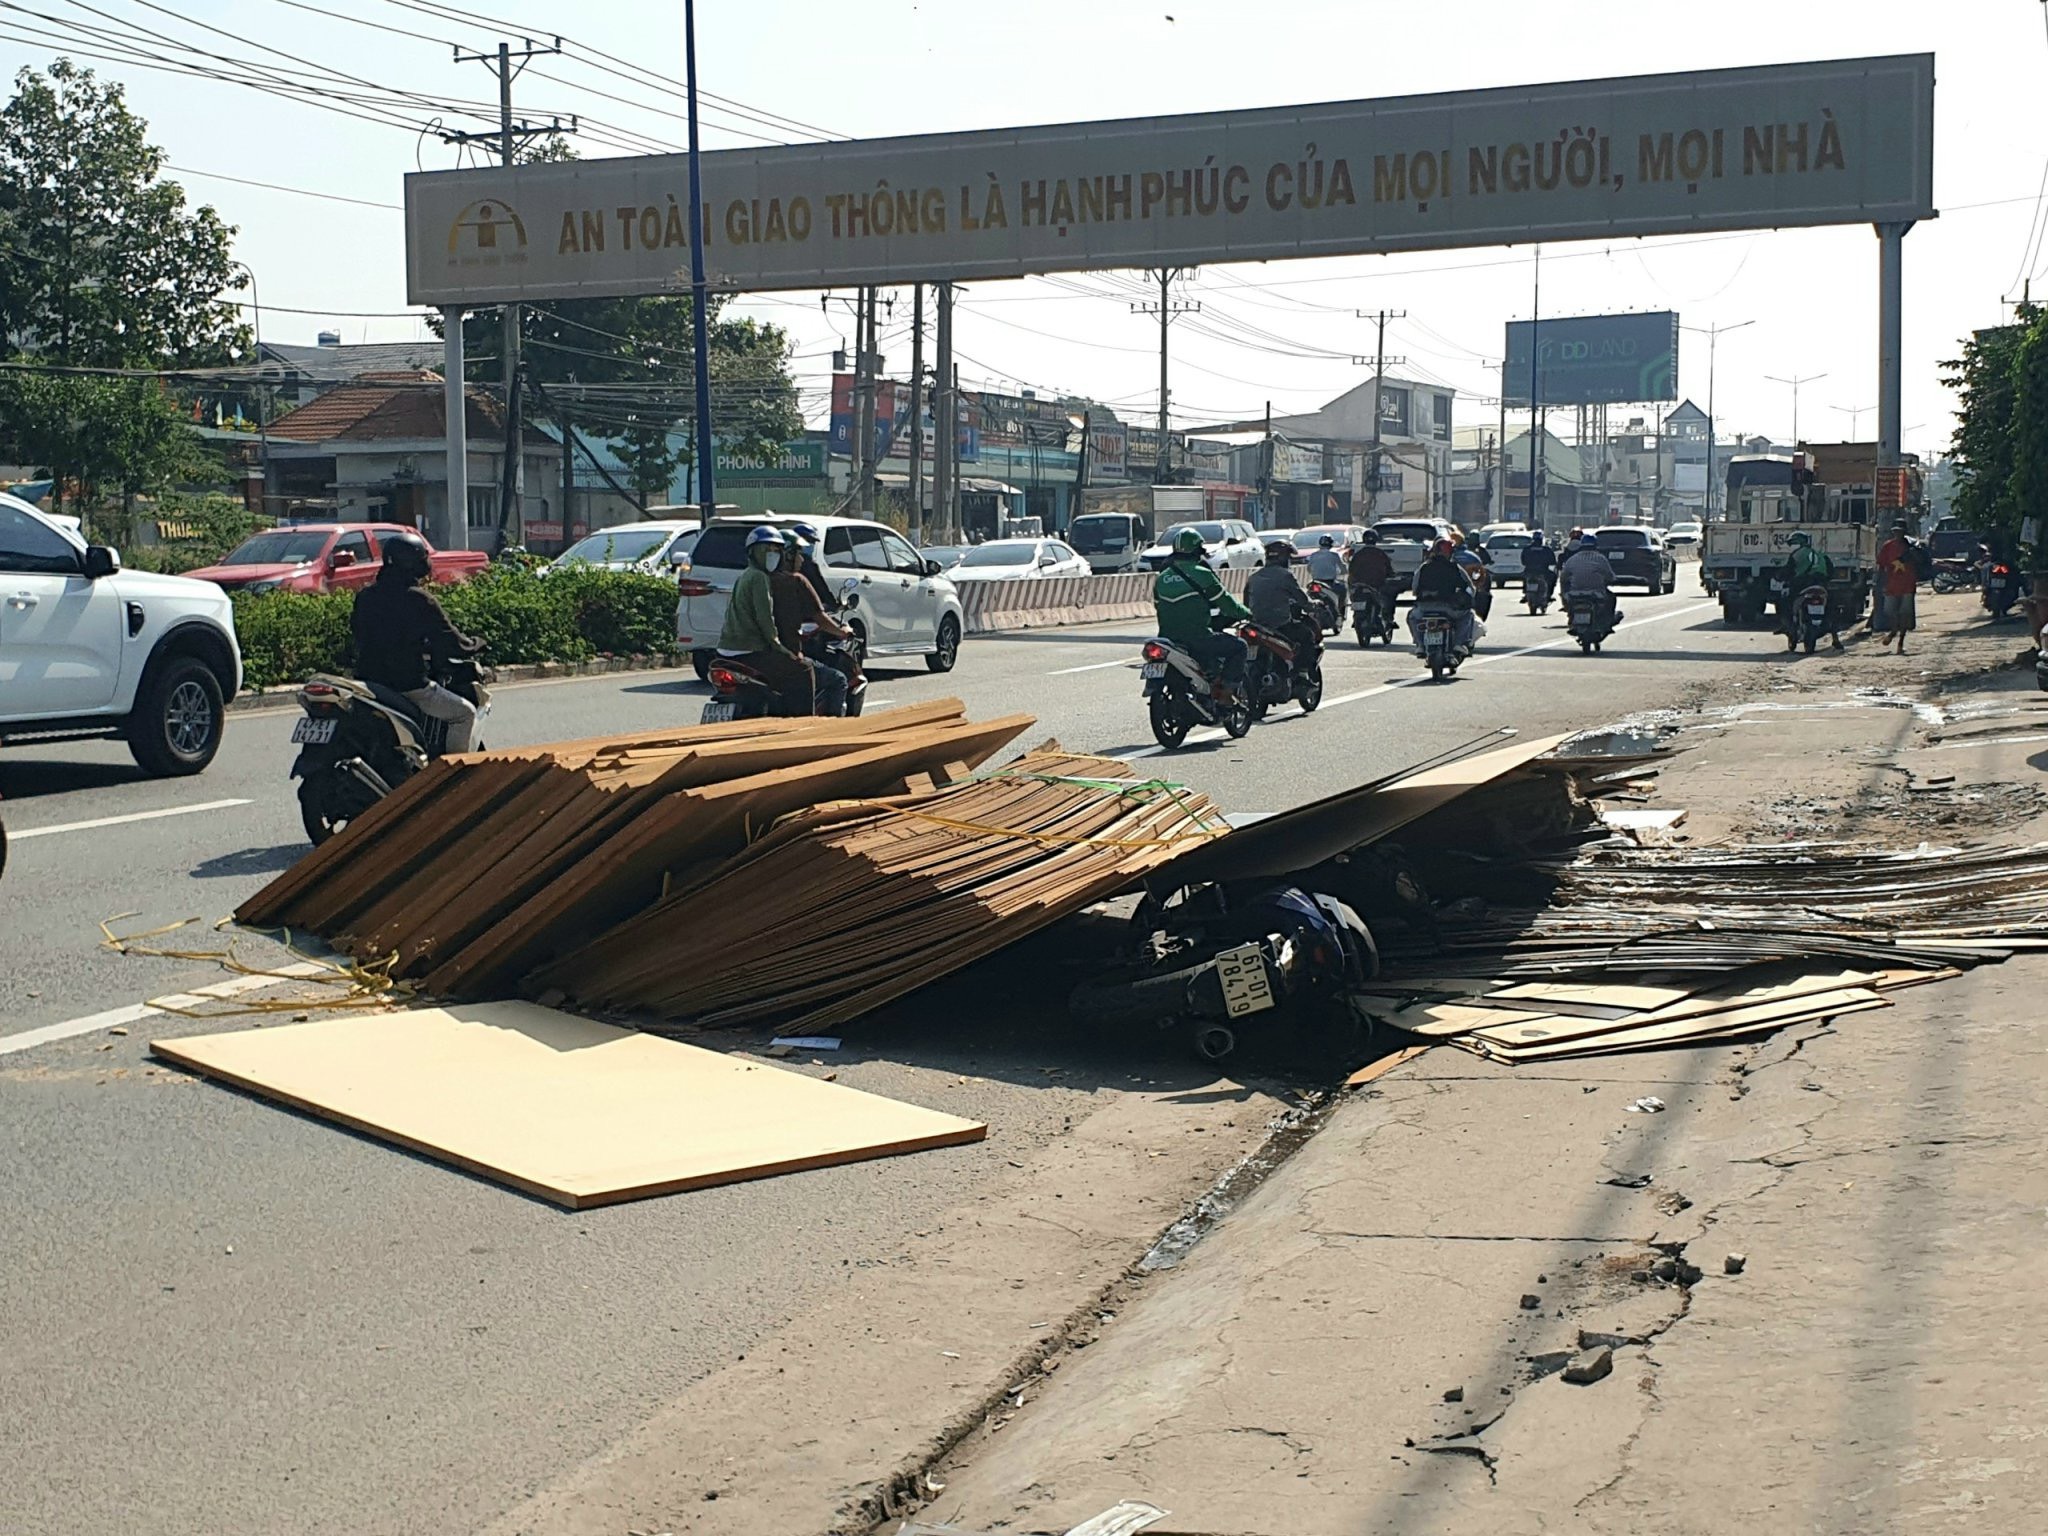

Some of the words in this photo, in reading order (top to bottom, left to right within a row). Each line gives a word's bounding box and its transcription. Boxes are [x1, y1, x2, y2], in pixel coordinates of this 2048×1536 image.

[558, 209, 605, 255] AN
[725, 196, 812, 246] GIAO
[823, 178, 947, 238] THÔNG
[960, 170, 1009, 231] LÀ
[1021, 174, 1133, 237] HẠNH
[1140, 155, 1250, 219] PHÚC
[1265, 142, 1356, 211] CỦA
[1373, 149, 1451, 213] MỌI
[1468, 125, 1624, 195] NGƯỜI,
[1638, 128, 1723, 194] MỌI
[1743, 107, 1846, 177] NHÀ
[773, 453, 812, 472] HỊNH
[1162, 573, 1192, 584] Gra
[1220, 954, 1250, 1013] 784.19
[1242, 954, 1269, 1000] 61-D1
